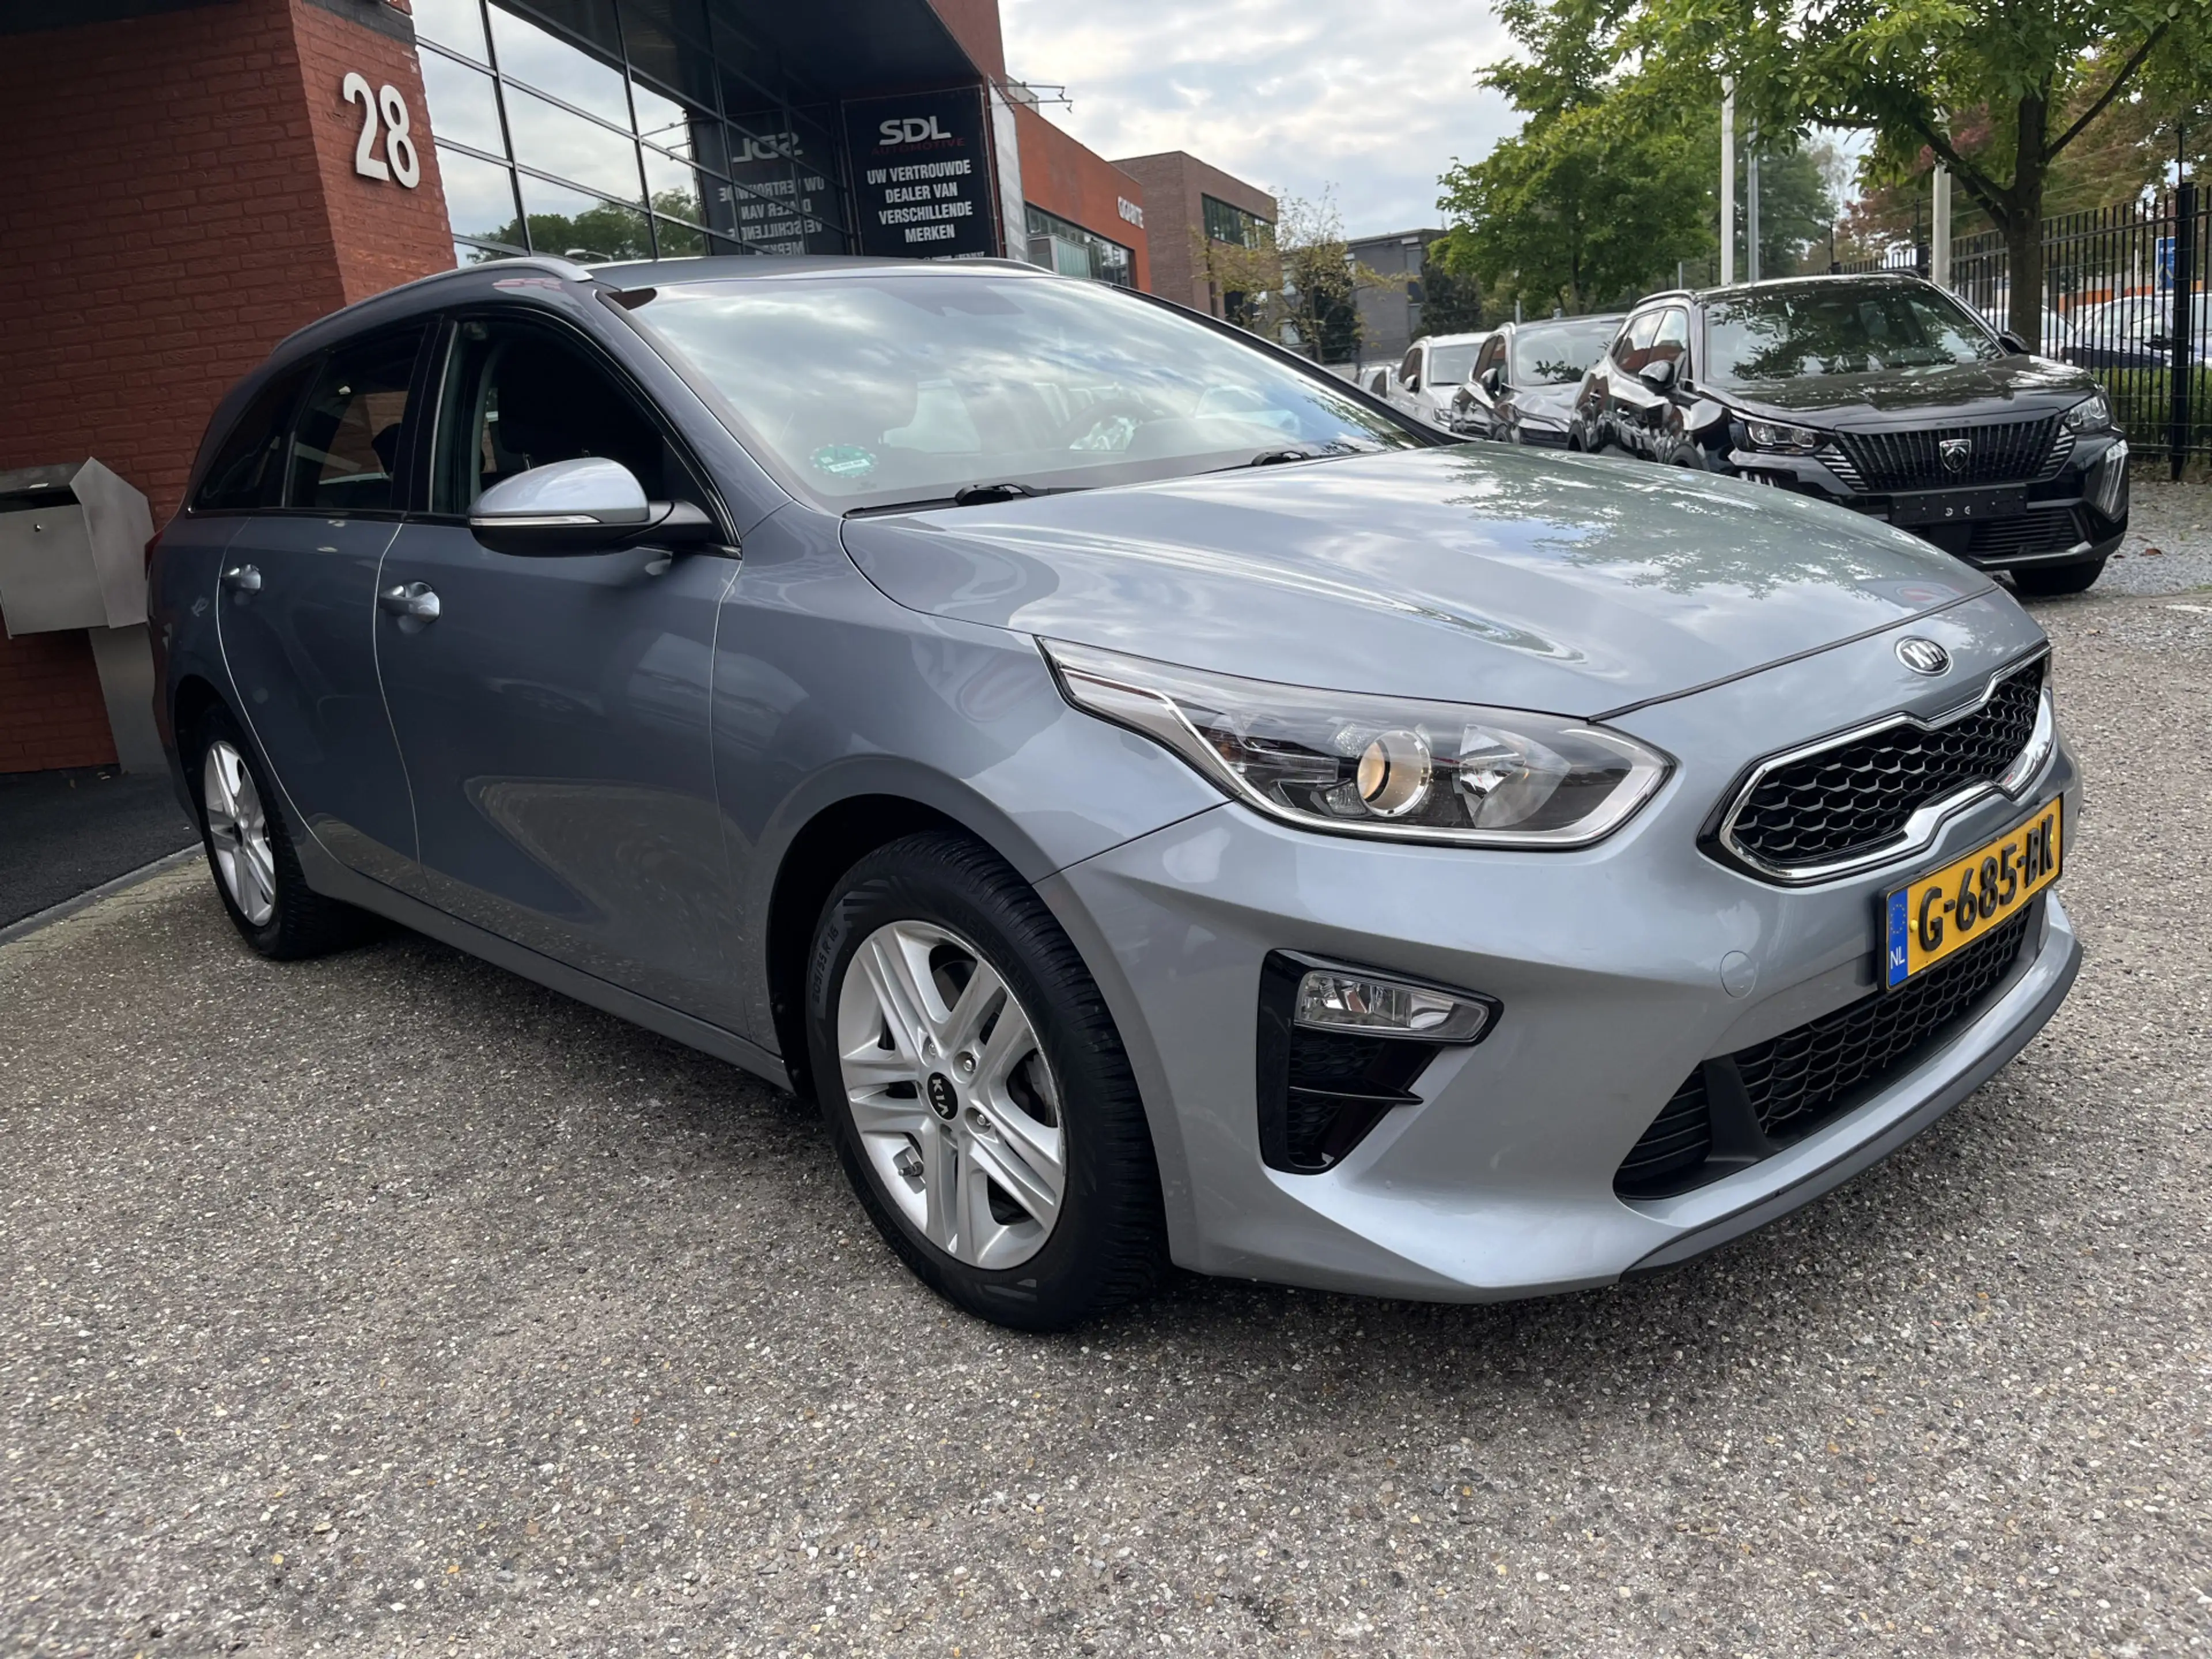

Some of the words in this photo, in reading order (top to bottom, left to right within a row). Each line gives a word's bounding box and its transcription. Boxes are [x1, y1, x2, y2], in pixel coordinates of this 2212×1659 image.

[343, 72, 420, 189] 28
[879, 116, 952, 145] SDL
[866, 169, 887, 185] UW
[889, 159, 972, 183] VERTROUWDE
[885, 185, 931, 204] DEALER
[933, 181, 959, 198] VAN
[878, 200, 974, 226] VERSCHILLENDE
[904, 224, 956, 243] MERKEN
[1903, 640, 1948, 668] KIA
[1918, 813, 2054, 952] G-685-BK
[1890, 946, 1906, 969] NL
[932, 1078, 949, 1116] KIA
